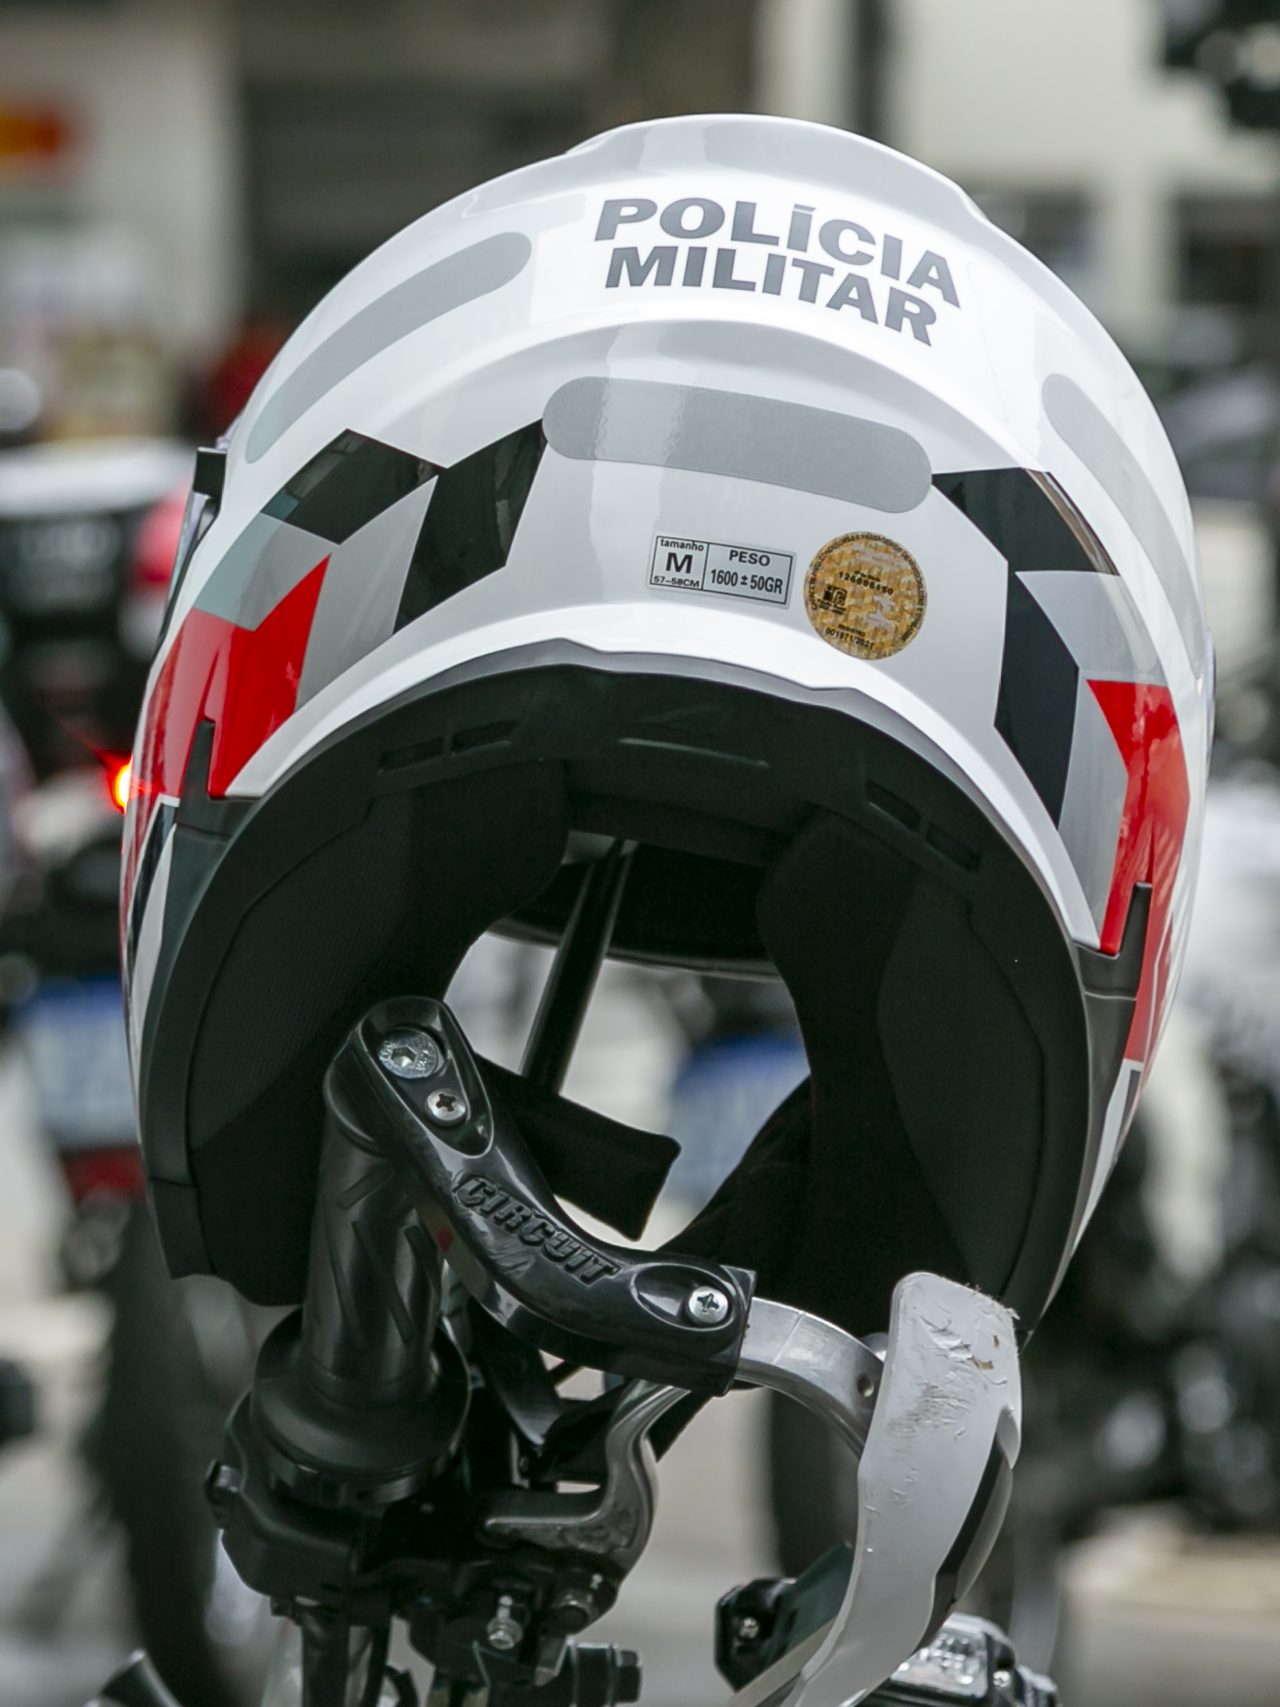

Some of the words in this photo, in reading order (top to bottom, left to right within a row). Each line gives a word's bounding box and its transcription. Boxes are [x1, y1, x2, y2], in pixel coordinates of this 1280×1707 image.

[594, 197, 961, 309] POLÍCIA
[605, 245, 937, 347] MILITAR
[660, 538, 704, 551] tamanho
[665, 552, 693, 574] M
[729, 549, 770, 566] PESO
[710, 569, 738, 587] 1600
[750, 574, 783, 594] 50GR
[455, 1175, 618, 1284] CIRCUIT
